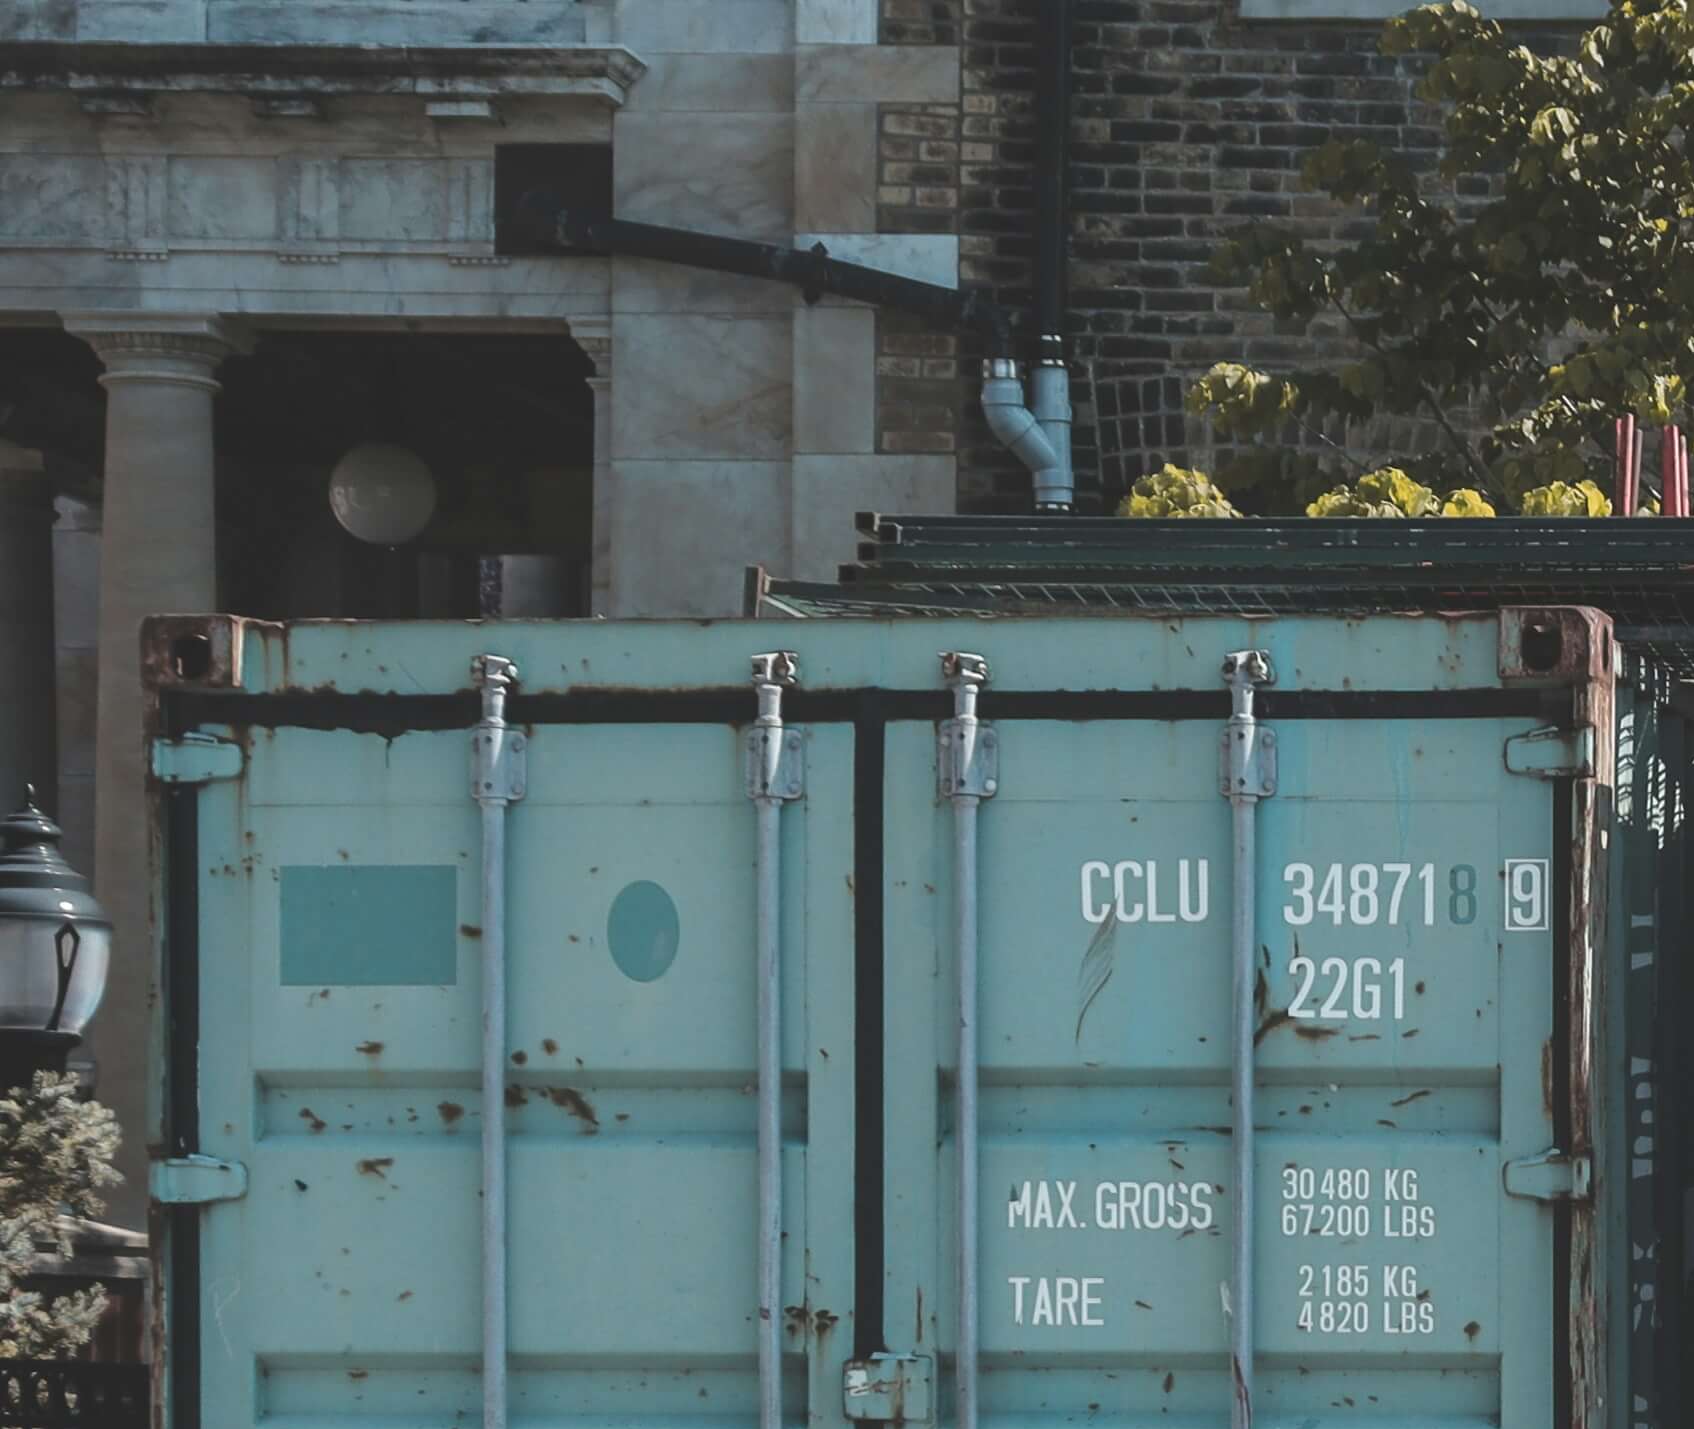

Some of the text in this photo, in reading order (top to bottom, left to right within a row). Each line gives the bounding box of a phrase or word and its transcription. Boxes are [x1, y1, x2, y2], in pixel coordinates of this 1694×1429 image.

[1080, 859, 1209, 923] CCLU
[1512, 863, 1541, 926] 9
[1287, 956, 1404, 1019] 22G1
[1384, 1169, 1417, 1201] KG
[1008, 1181, 1213, 1230] MAX. GROSS
[1384, 1205, 1435, 1237] LBS
[1384, 1265, 1417, 1297] KG
[1008, 1277, 1104, 1326] TARE
[1384, 1302, 1434, 1333] LBS
